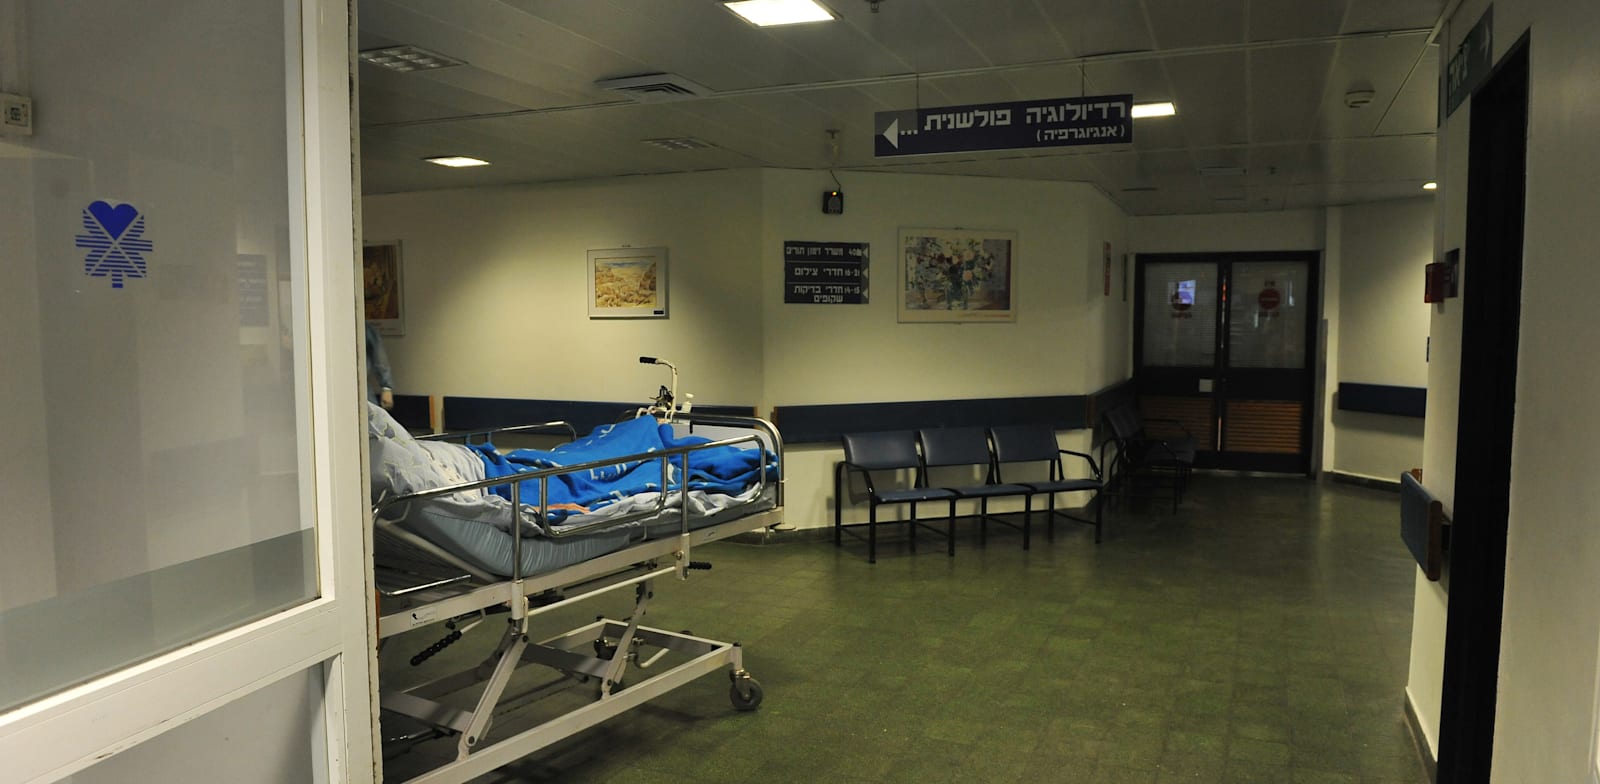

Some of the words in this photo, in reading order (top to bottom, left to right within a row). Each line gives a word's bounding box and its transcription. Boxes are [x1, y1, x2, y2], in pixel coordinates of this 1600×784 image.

[1026, 102, 1125, 124] רדיולוגיה
[786, 246, 805, 255] תורים
[824, 247, 844, 256] משרד
[794, 267, 818, 277] צילום
[823, 267, 843, 277] חדרי
[794, 285, 822, 295] בדיקות
[825, 285, 843, 294] חדרי
